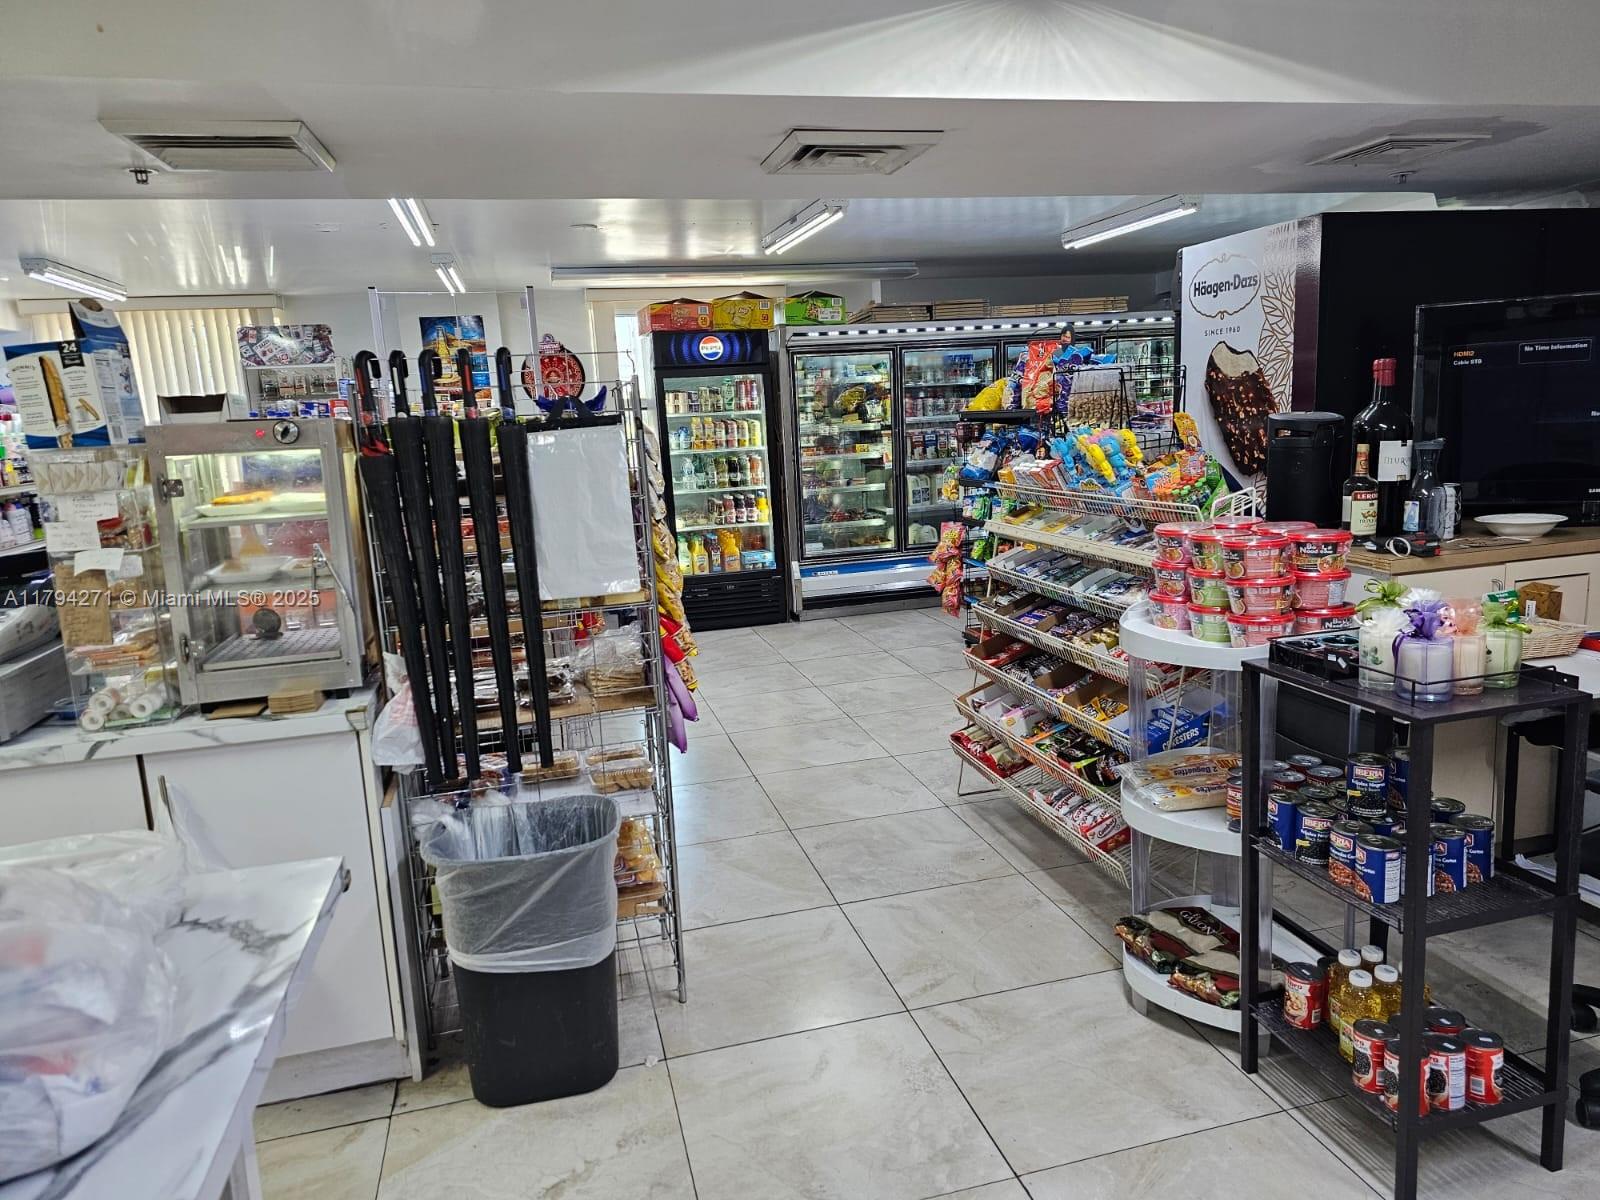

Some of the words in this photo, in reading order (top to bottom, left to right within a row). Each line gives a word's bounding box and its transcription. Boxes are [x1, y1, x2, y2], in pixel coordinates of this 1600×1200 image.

[1204, 327, 1223, 337] SINCE
[1225, 325, 1241, 335] 1960
[61, 343, 78, 353] 24
[1550, 342, 1588, 350] Information
[1453, 358, 1470, 366] Cable
[1173, 766, 1212, 777] Baguettes
[1355, 768, 1384, 780] IBERIA
[1304, 819, 1331, 831] IBERIA
